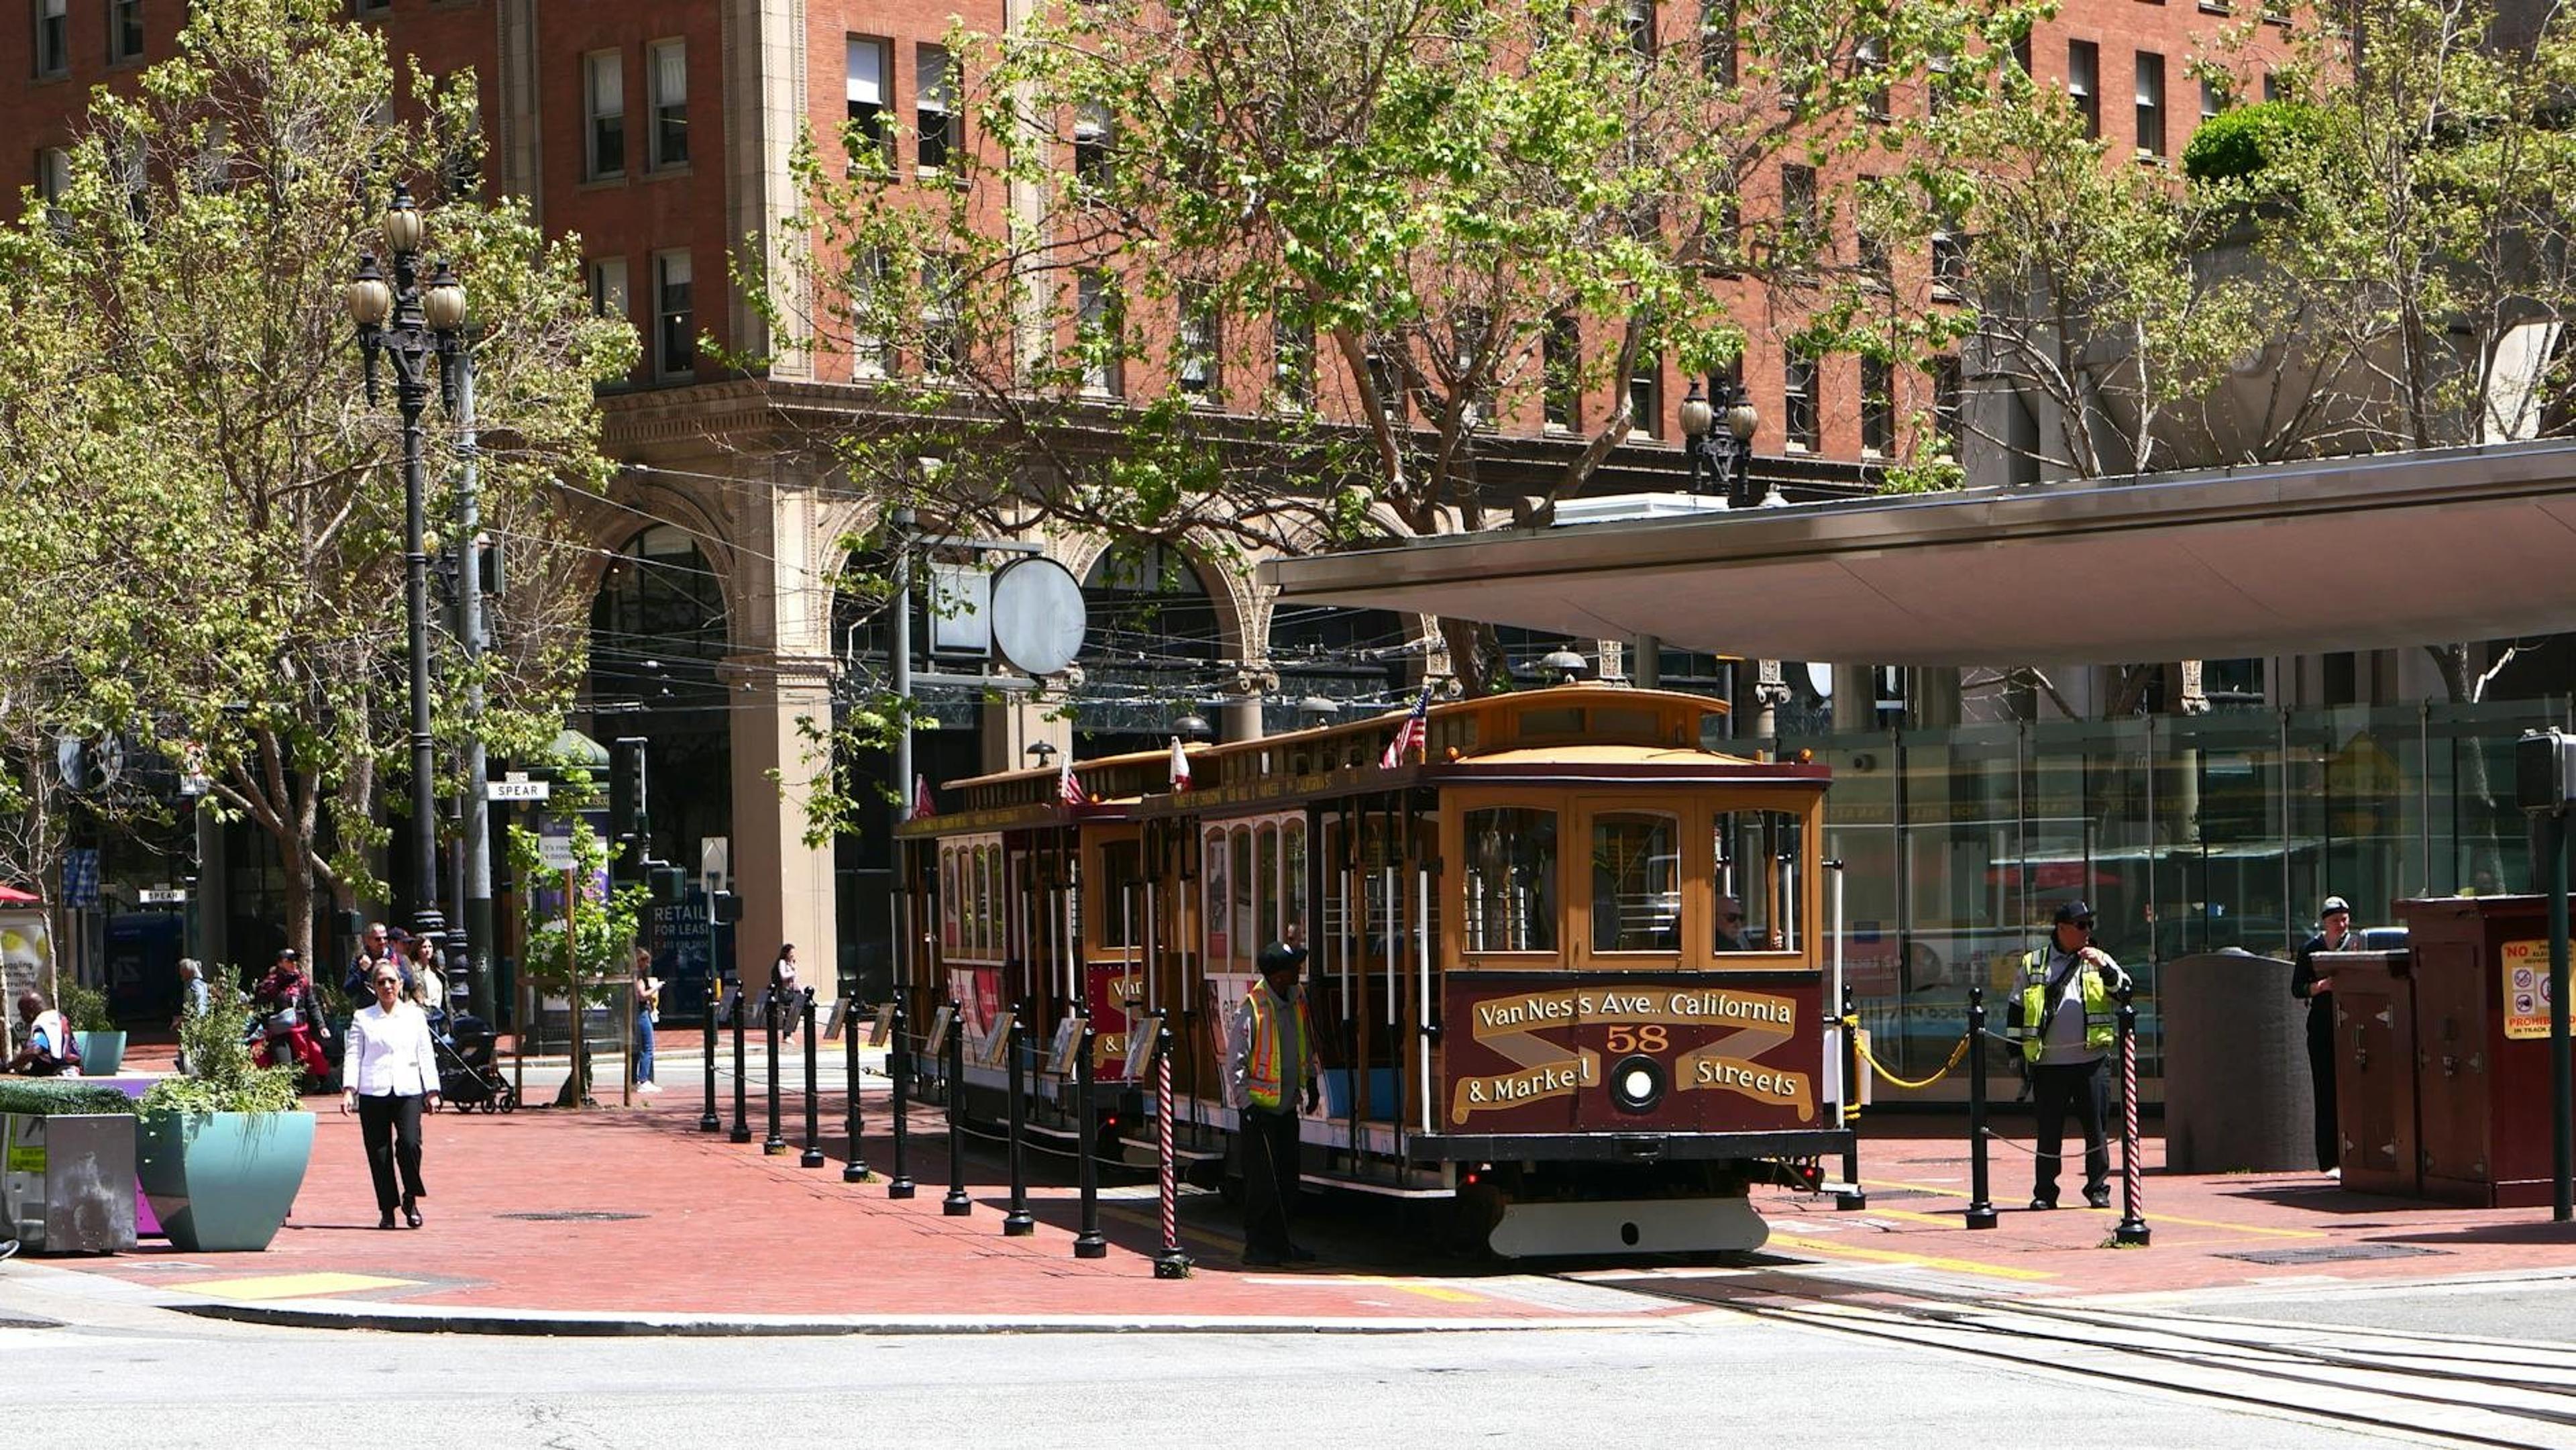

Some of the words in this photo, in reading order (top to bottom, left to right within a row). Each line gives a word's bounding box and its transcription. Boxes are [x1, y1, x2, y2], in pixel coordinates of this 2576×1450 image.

[498, 786, 538, 796] SPEAR
[654, 905, 707, 921] RETAIL
[655, 924, 676, 936] FOR
[2507, 945, 2528, 957] NO
[1480, 1005, 1523, 1028] Van
[1527, 996, 1593, 1021] Ness
[1670, 992, 1791, 1024] California
[1105, 1035, 1119, 1052] &
[1607, 1025, 1669, 1053] 58
[1469, 1080, 1489, 1103] &
[1494, 1056, 1590, 1102] Market
[1696, 1061, 1798, 1096] Streets
